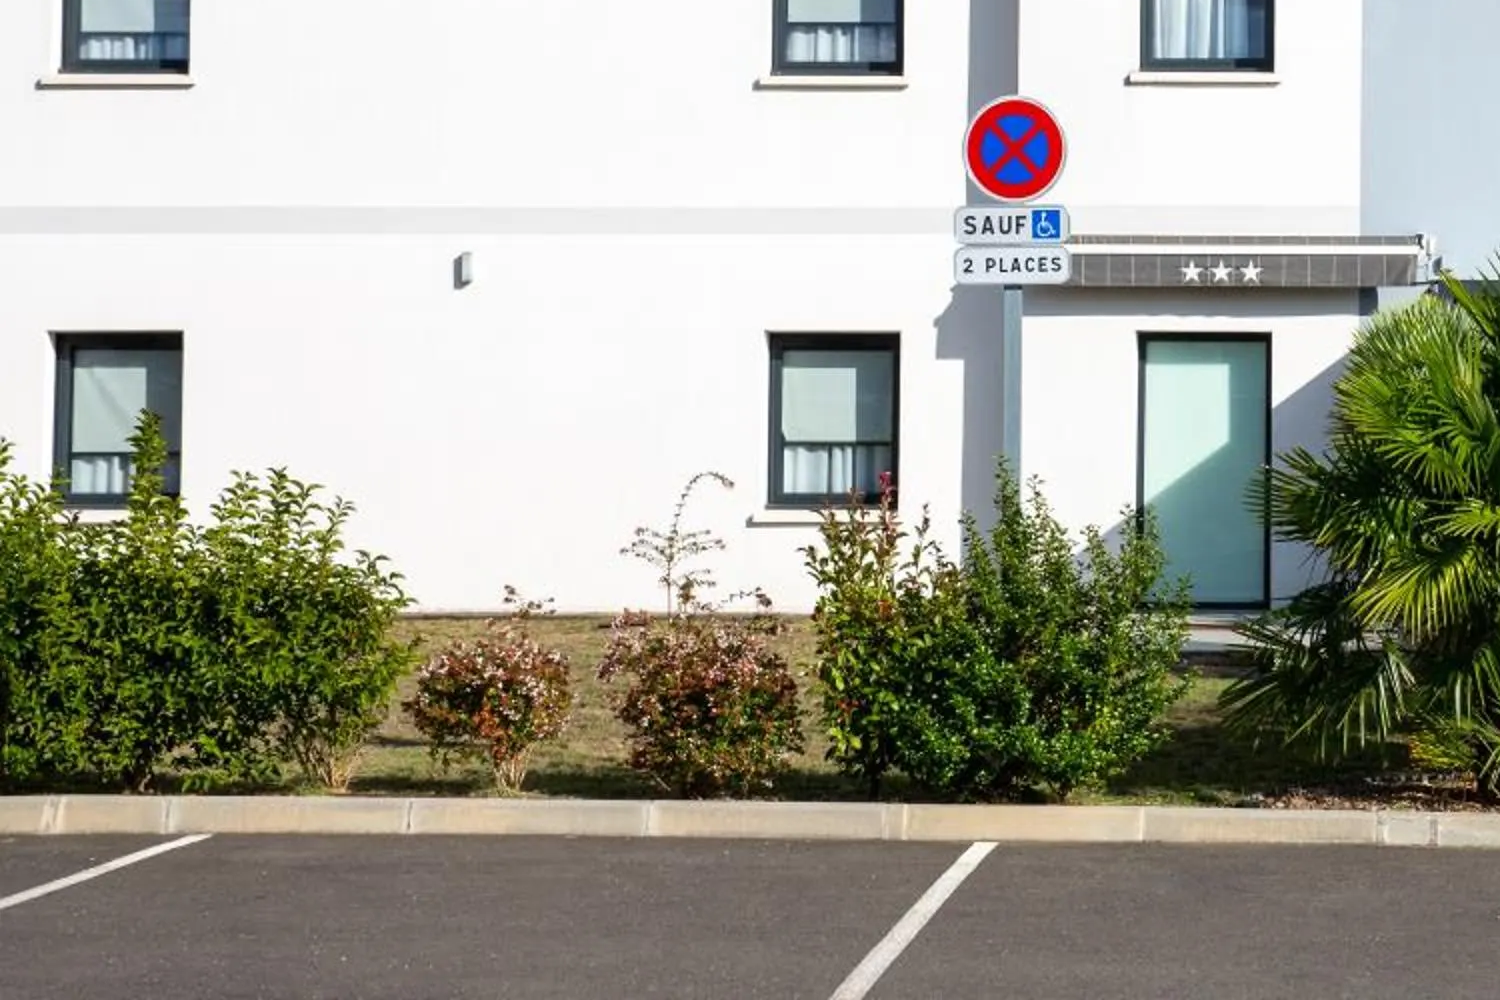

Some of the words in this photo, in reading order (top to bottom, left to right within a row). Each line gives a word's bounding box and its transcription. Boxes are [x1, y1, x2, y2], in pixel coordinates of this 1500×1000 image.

[963, 215, 1027, 235] SAUF
[963, 258, 973, 273] 2
[986, 257, 1062, 273] PLACES
